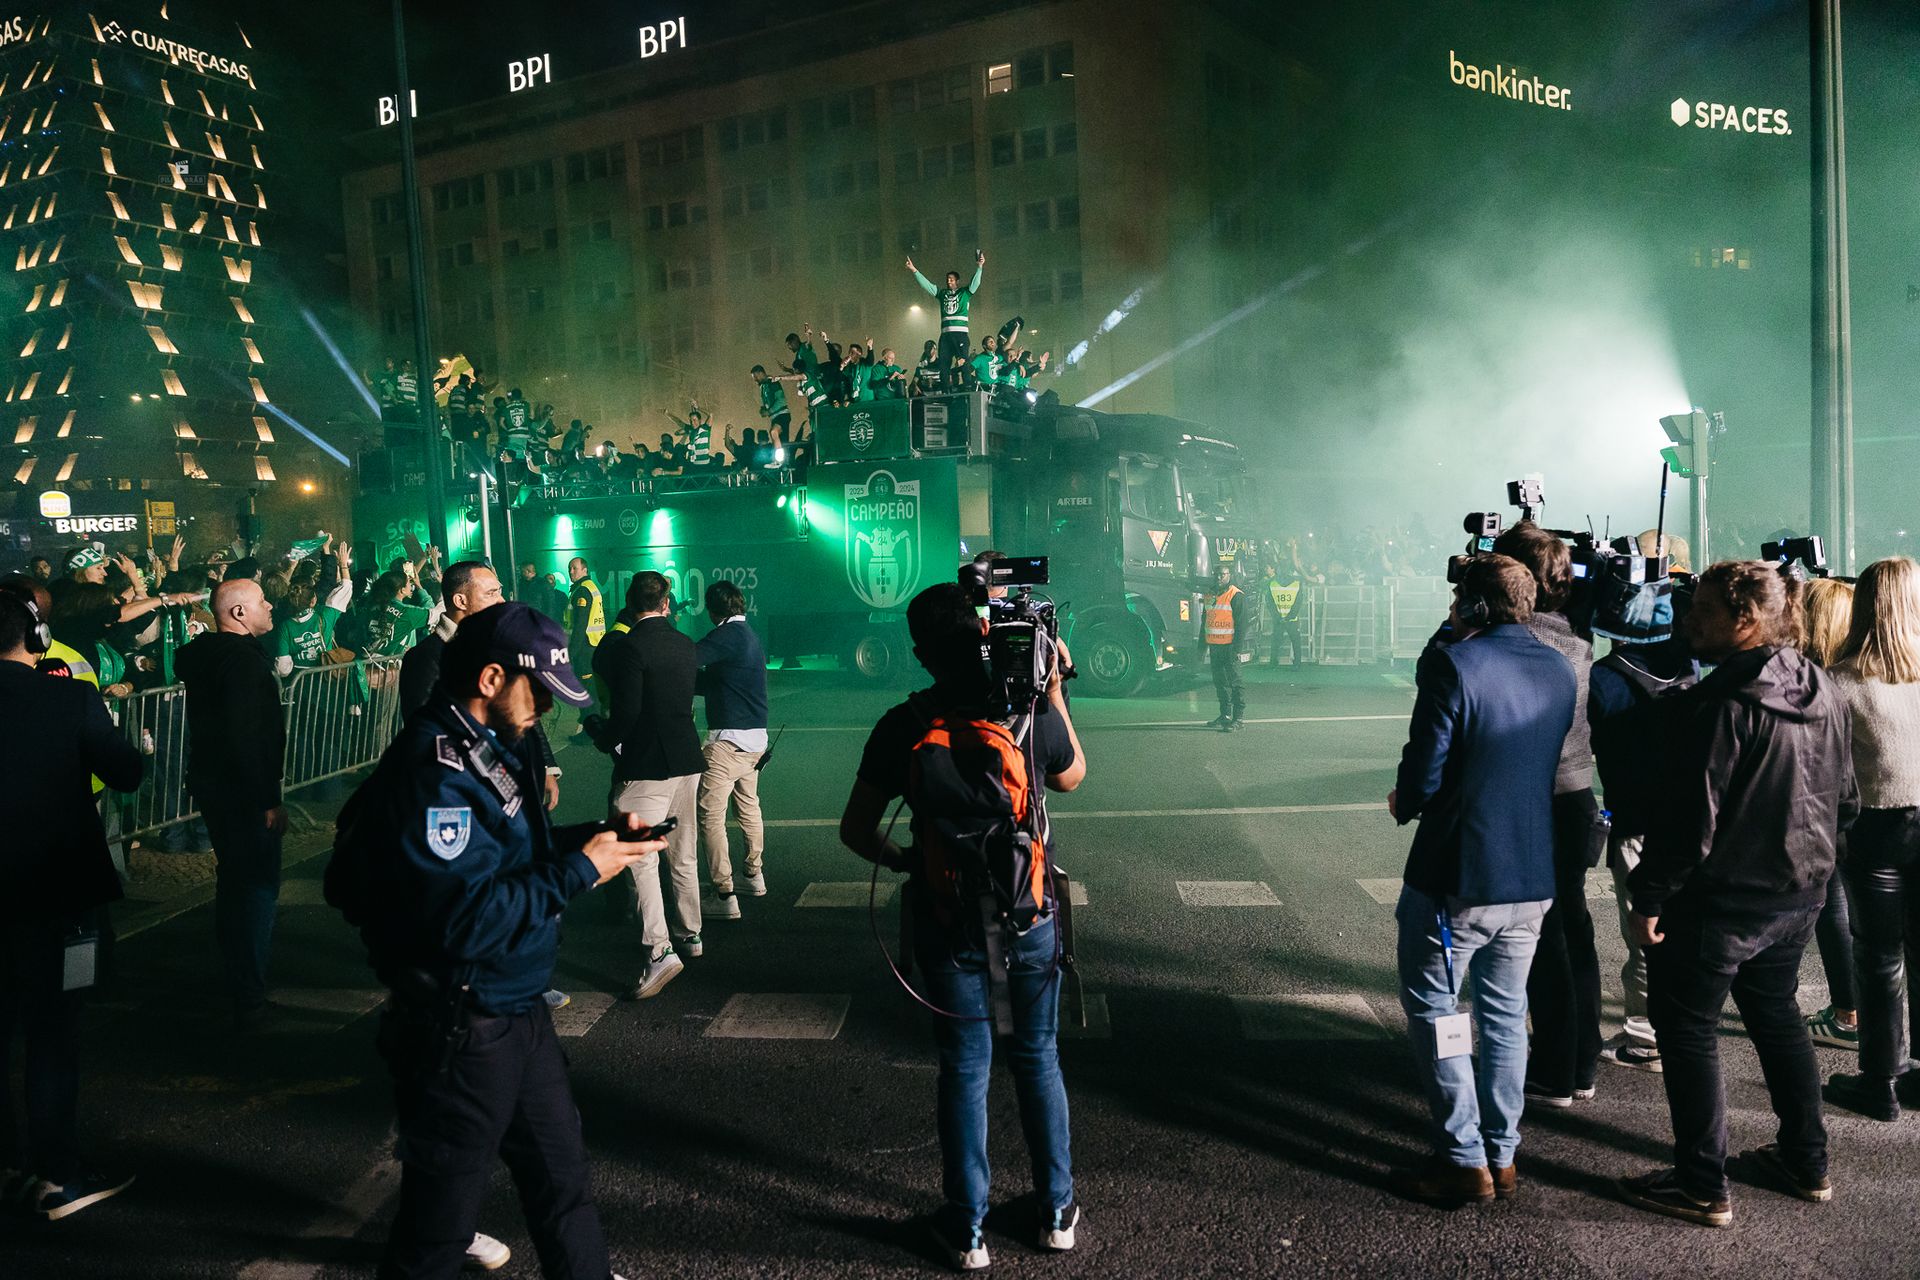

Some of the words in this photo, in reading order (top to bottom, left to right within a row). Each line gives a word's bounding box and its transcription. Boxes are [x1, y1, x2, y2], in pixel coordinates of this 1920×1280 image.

[130, 29, 249, 81] CUATRECASAS
[639, 16, 687, 58] BPI
[508, 53, 551, 92] BPI
[1449, 50, 1572, 111] bankinter.
[378, 89, 417, 126] BI
[1694, 101, 1793, 136] SPACES.
[852, 412, 870, 421] SCP
[55, 517, 138, 533] BURGER
[850, 499, 914, 521] CAMPEÃO
[1276, 593, 1292, 602] 183
